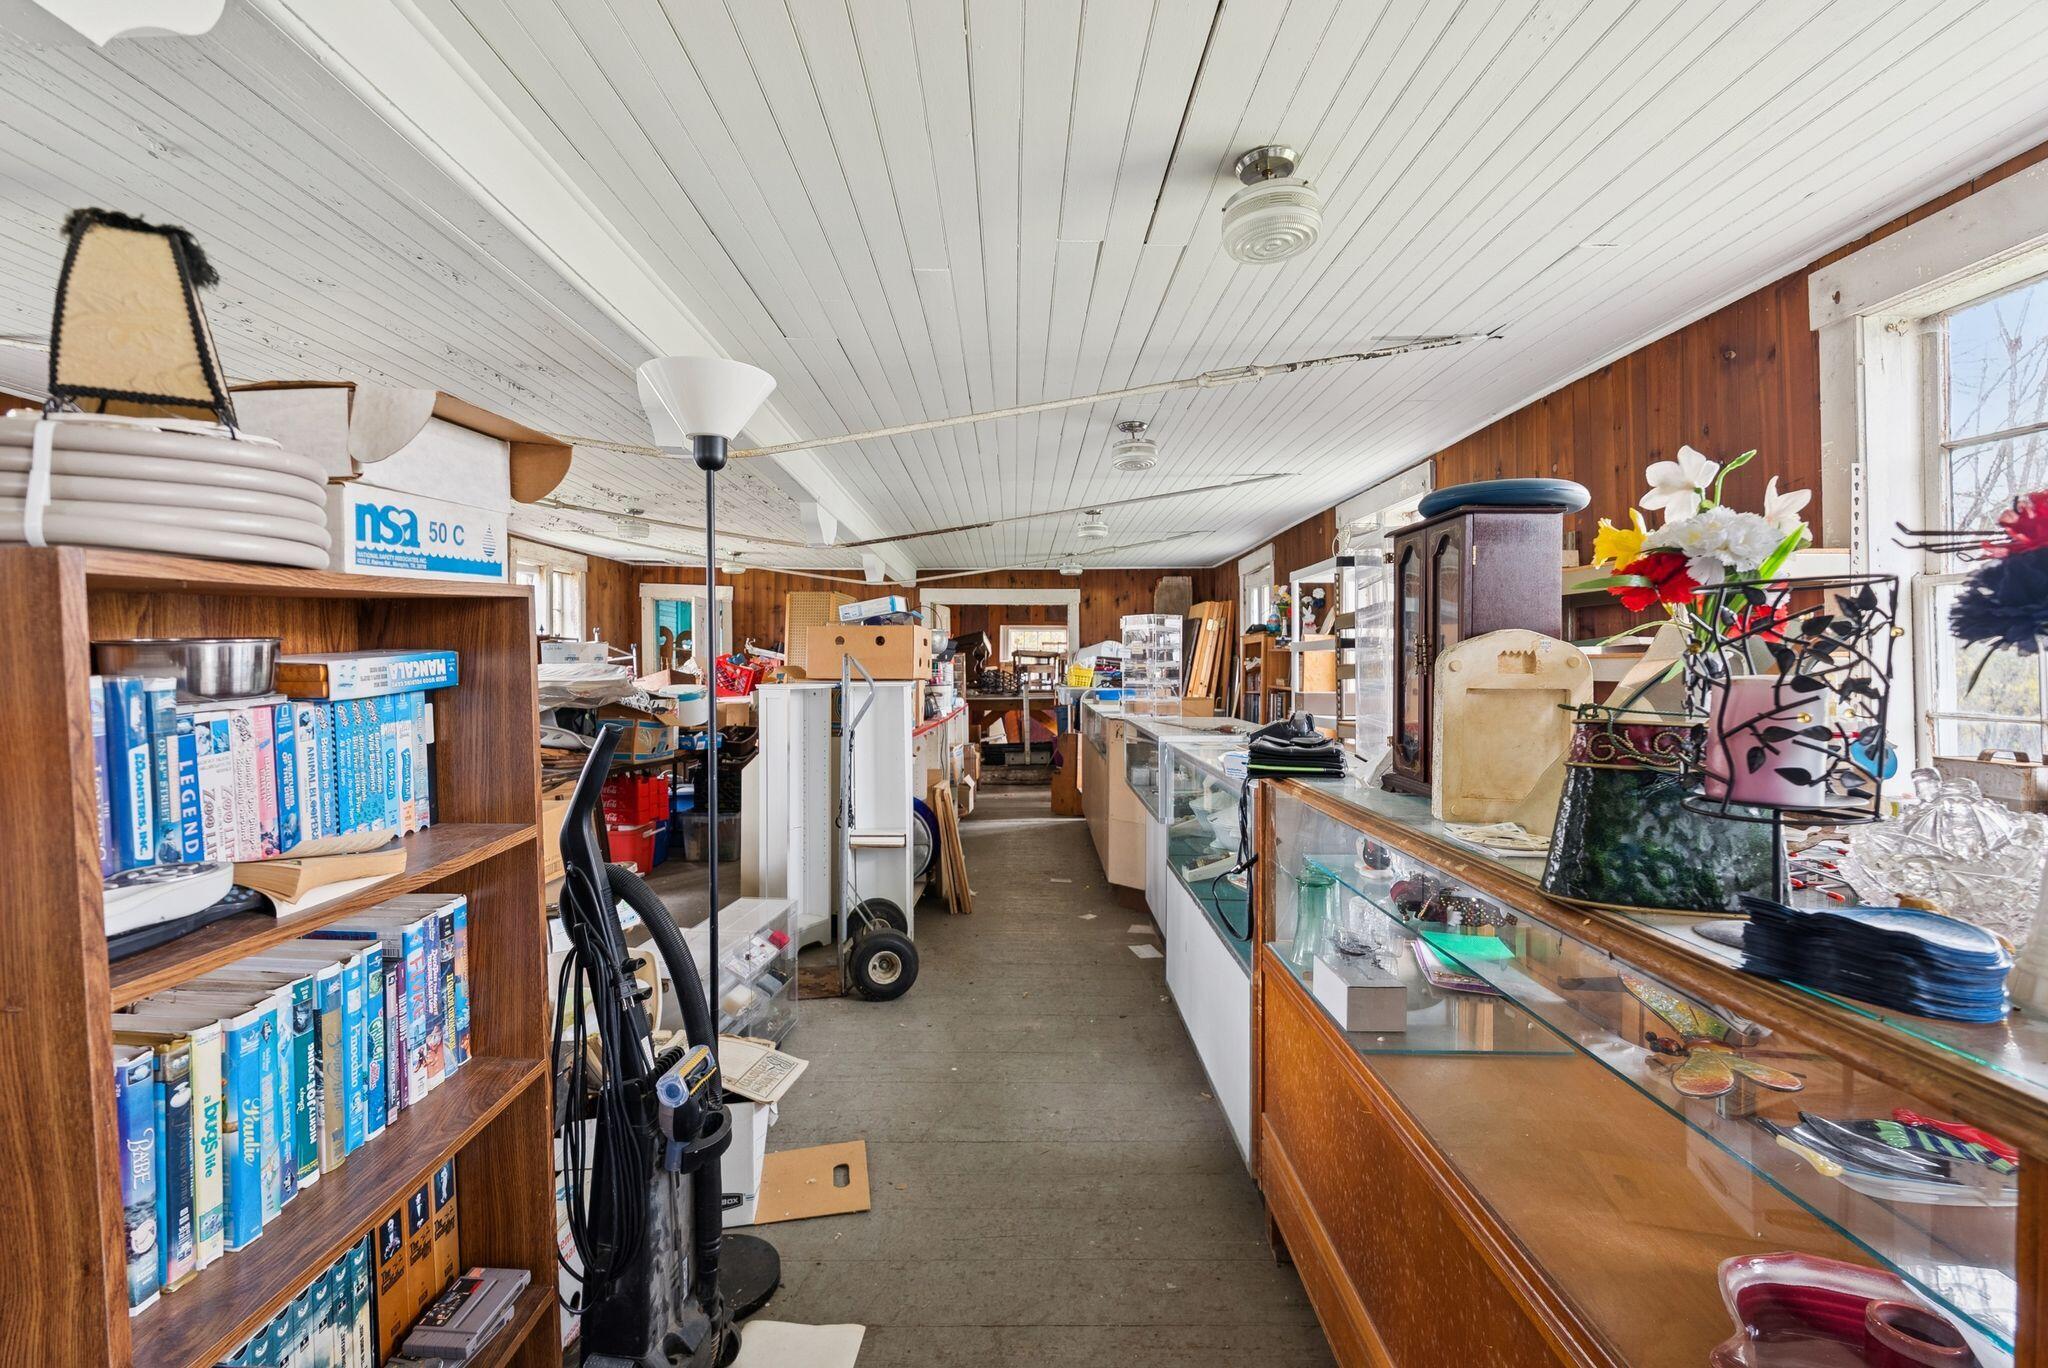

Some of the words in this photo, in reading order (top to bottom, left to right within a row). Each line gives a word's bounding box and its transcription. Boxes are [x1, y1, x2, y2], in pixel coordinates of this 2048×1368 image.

[355, 503, 420, 548] nsa
[429, 521, 447, 544] 50
[453, 525, 465, 546] C
[389, 658, 447, 680] MANCALA
[158, 739, 167, 756] ON
[320, 736, 330, 772] Behind
[368, 733, 376, 751] Wild
[375, 732, 383, 766] Elephant
[281, 751, 288, 765] OF
[306, 746, 317, 788] ANIMAL
[286, 753, 295, 807] CREATURES
[321, 773, 331, 790] the
[354, 772, 362, 795] Little
[360, 771, 368, 802] Animals
[376, 767, 384, 794] Babies
[159, 780, 170, 822] STREET
[179, 760, 200, 854] LEGEND
[283, 785, 292, 810] DEEP
[323, 792, 332, 829] Scenes
[309, 788, 320, 841] BLOOPERS
[139, 831, 149, 857] INC.
[408, 951, 428, 1021] FLUKE
[446, 981, 455, 1007] BOUND
[398, 992, 408, 1017] THEM
[368, 1016, 385, 1062] GRINCH
[398, 1016, 408, 1042] IDIOTS
[307, 1042, 316, 1081] YOUNG
[350, 1023, 363, 1089] Pinocchio
[203, 1095, 212, 1104] a
[306, 1080, 317, 1107] JOE
[391, 1081, 399, 1106] CELL
[241, 1098, 262, 1168] Paulie
[308, 1106, 318, 1144] MIGHTY
[126, 1128, 155, 1190] BABE
[203, 1154, 216, 1179] life
